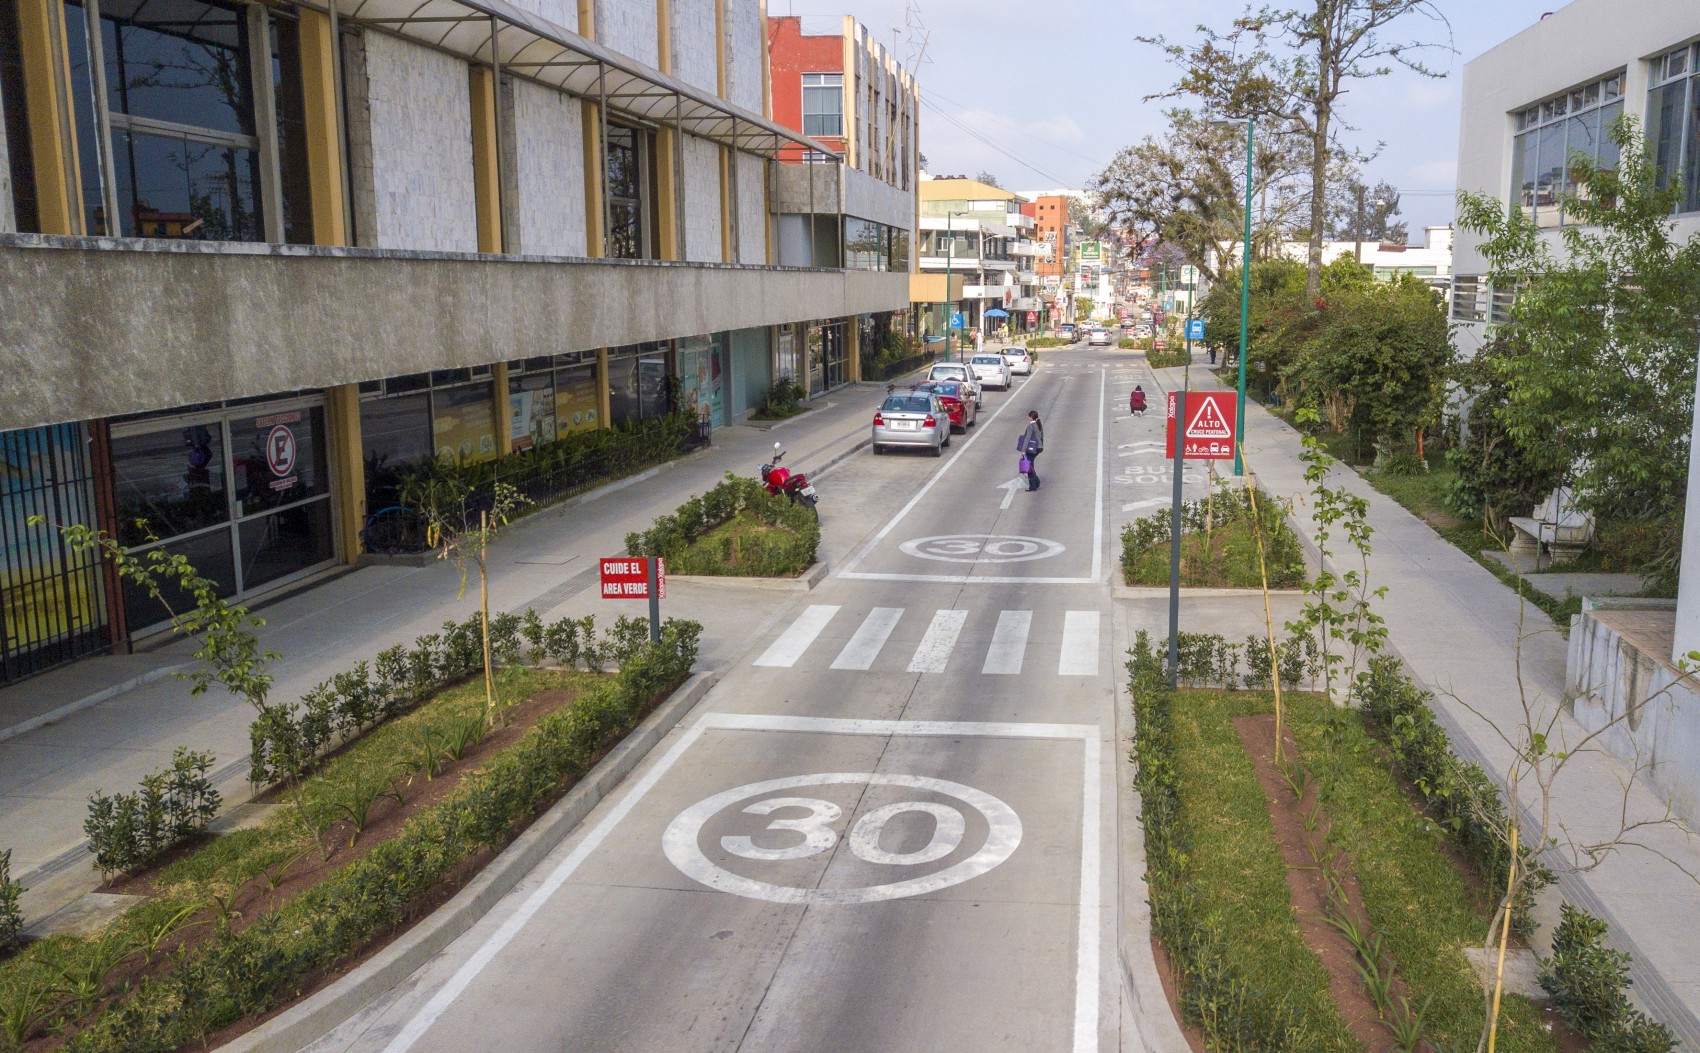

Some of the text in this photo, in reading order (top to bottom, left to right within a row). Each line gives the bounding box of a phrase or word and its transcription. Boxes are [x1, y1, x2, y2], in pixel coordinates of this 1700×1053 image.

[1168, 396, 1176, 418] Xalapa
[1197, 420, 1220, 428] ALTO
[1114, 475, 1203, 484] SOLO
[926, 540, 1038, 555] 30
[604, 563, 641, 574] CUIDE EL
[603, 583, 647, 594] AREA VERDE
[720, 797, 965, 865] 30
